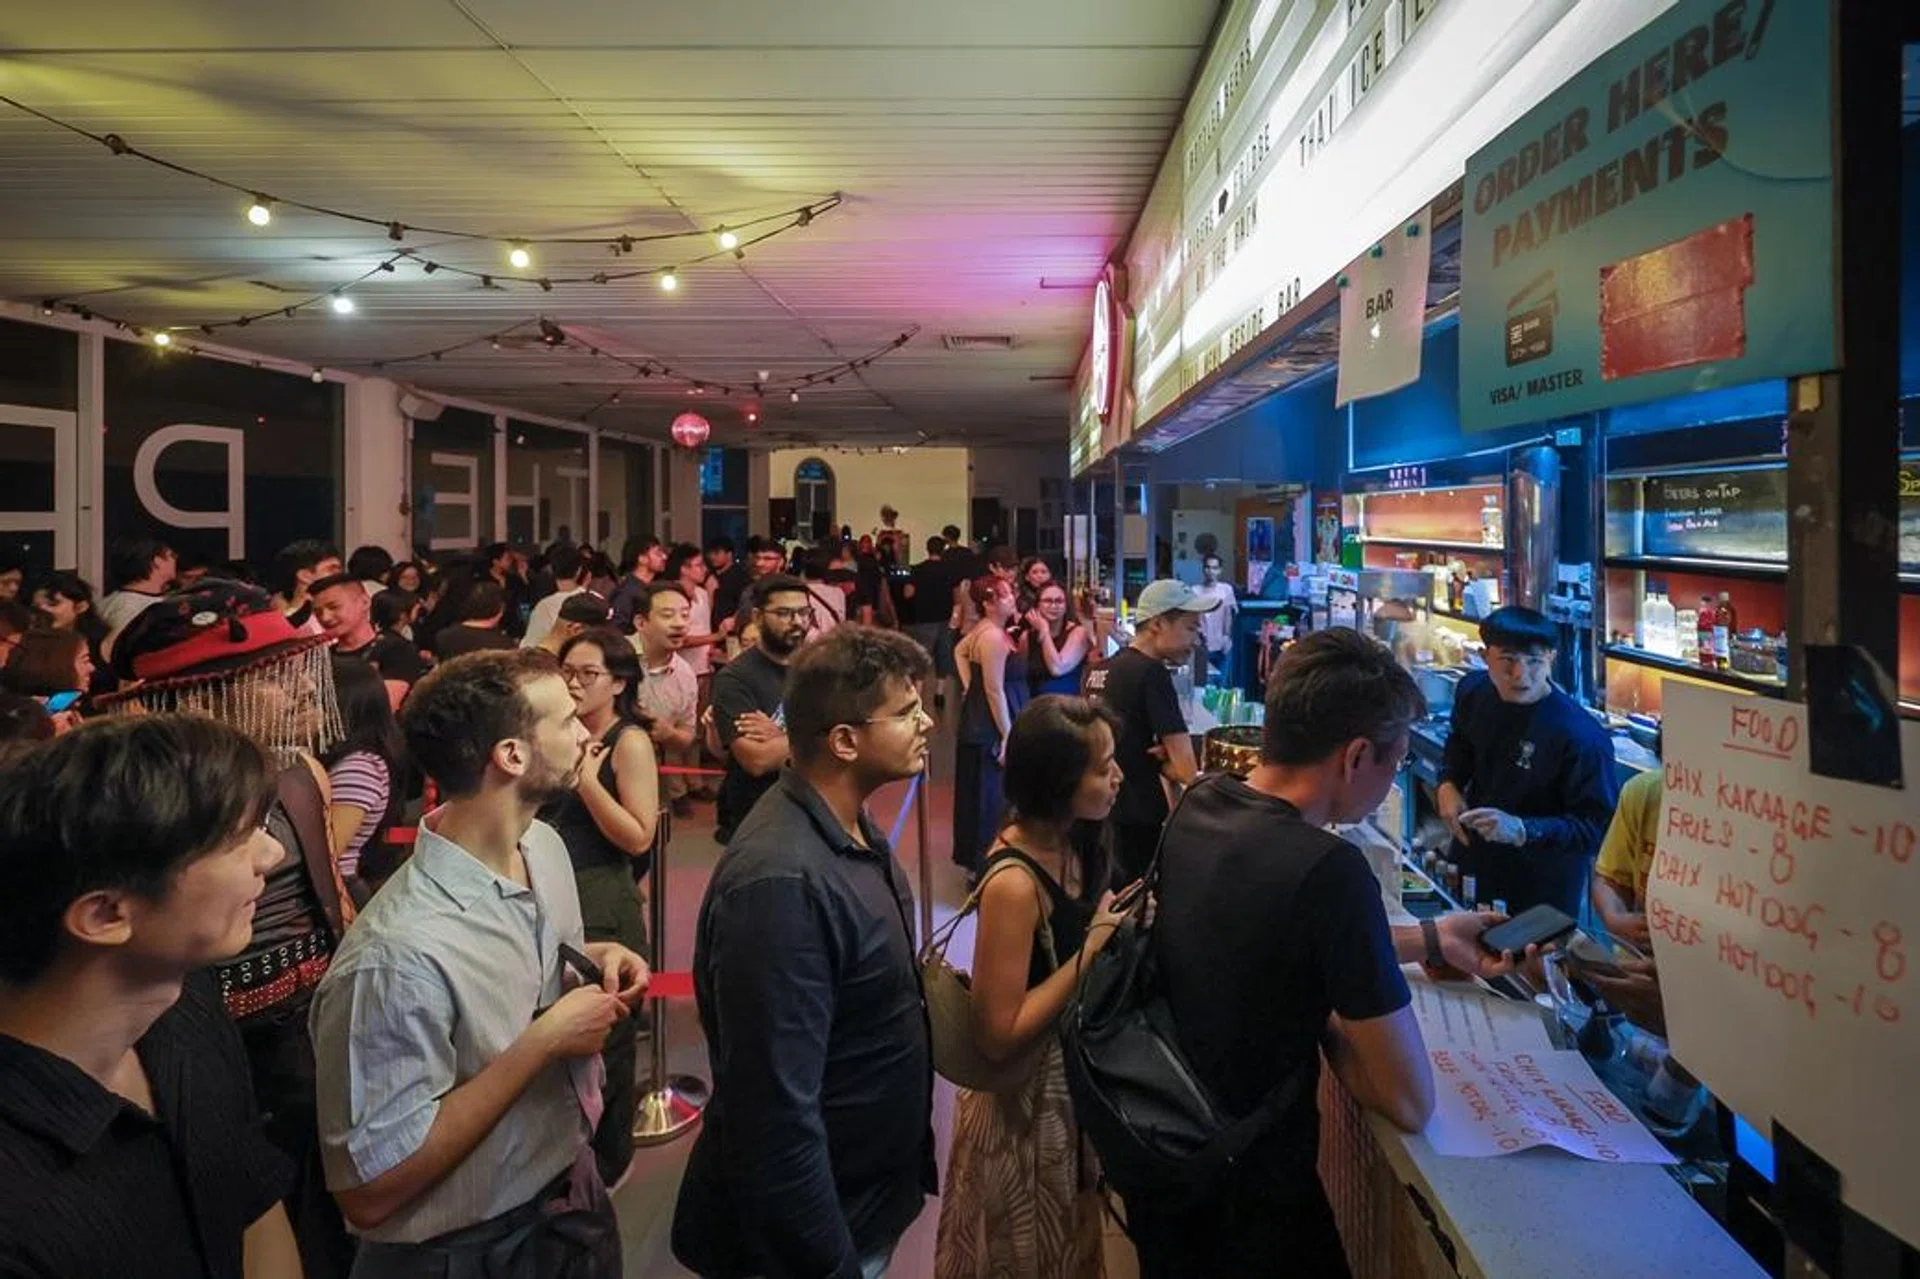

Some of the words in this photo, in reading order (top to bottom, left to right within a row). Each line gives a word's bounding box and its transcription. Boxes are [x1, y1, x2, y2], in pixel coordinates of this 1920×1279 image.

[1224, 37, 1251, 108] BEERS
[1300, 92, 1334, 168] THAI
[1350, 30, 1382, 108] ICE
[1233, 121, 1270, 198] FRIDGE
[1474, 105, 1590, 216] ORDER
[1492, 101, 1729, 269] PAYMENTS
[1228, 306, 1264, 355] BESIDE
[1278, 276, 1300, 317] BAR
[1366, 288, 1393, 319] BAR
[1526, 368, 1584, 396] MASTER
[1731, 704, 1799, 752] FOOD
[1872, 920, 1906, 983] 8
